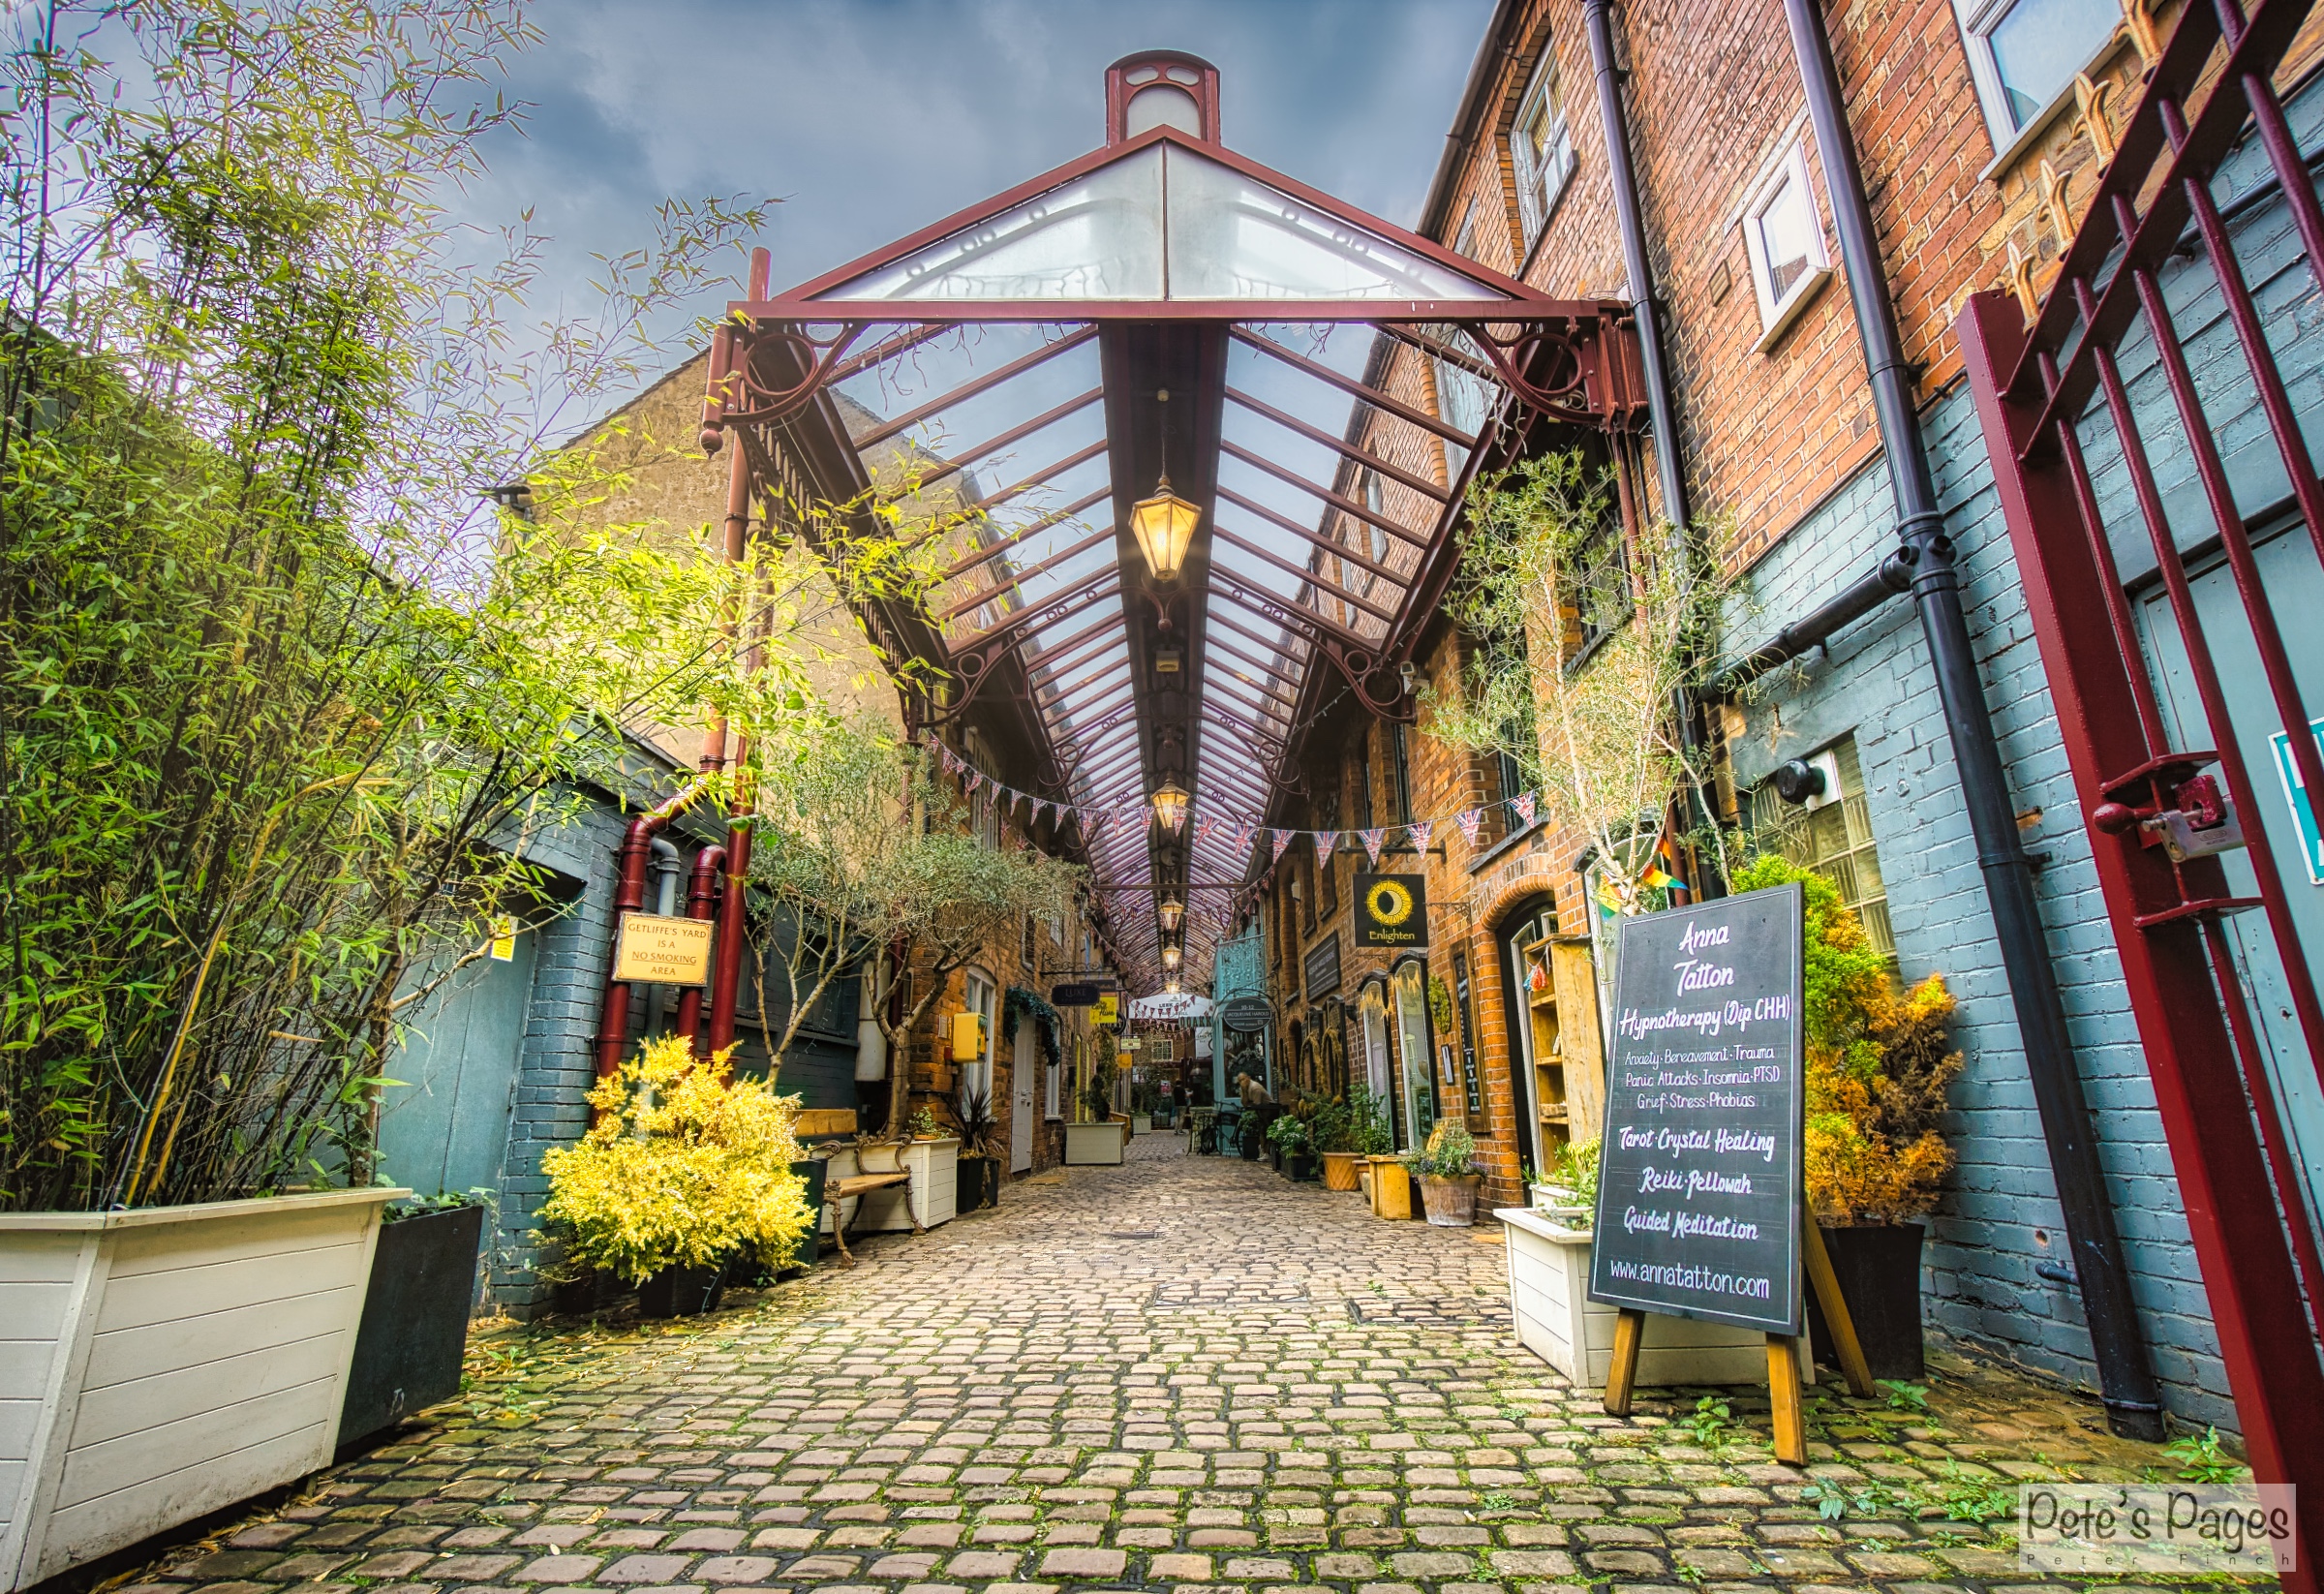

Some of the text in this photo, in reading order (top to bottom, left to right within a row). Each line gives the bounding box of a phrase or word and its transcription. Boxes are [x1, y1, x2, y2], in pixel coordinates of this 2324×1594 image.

[627, 923, 707, 938] GETLIFFE'S YARD
[1369, 928, 1415, 944] Enlighten
[1678, 921, 1729, 955] Anna
[657, 939, 676, 949] IS A
[632, 951, 697, 965] NO SMOKING
[651, 966, 676, 975] AREA
[1673, 959, 1734, 996] Tatton
[1620, 1007, 1721, 1041] Hypnotherapy
[1755, 994, 1790, 1022] CHH)
[1733, 1045, 1775, 1060] Trauma
[1626, 1072, 1654, 1087] Panic
[1754, 1065, 1781, 1082] PTSD
[1709, 1091, 1756, 1108] Phobias
[1619, 1126, 1775, 1162] Tarot Crystal Healing
[1638, 1166, 1753, 1200] Reiki Pellowah
[1624, 1206, 1758, 1241] Guided Meditation
[1610, 1260, 1770, 1300] www.annatatton.com
